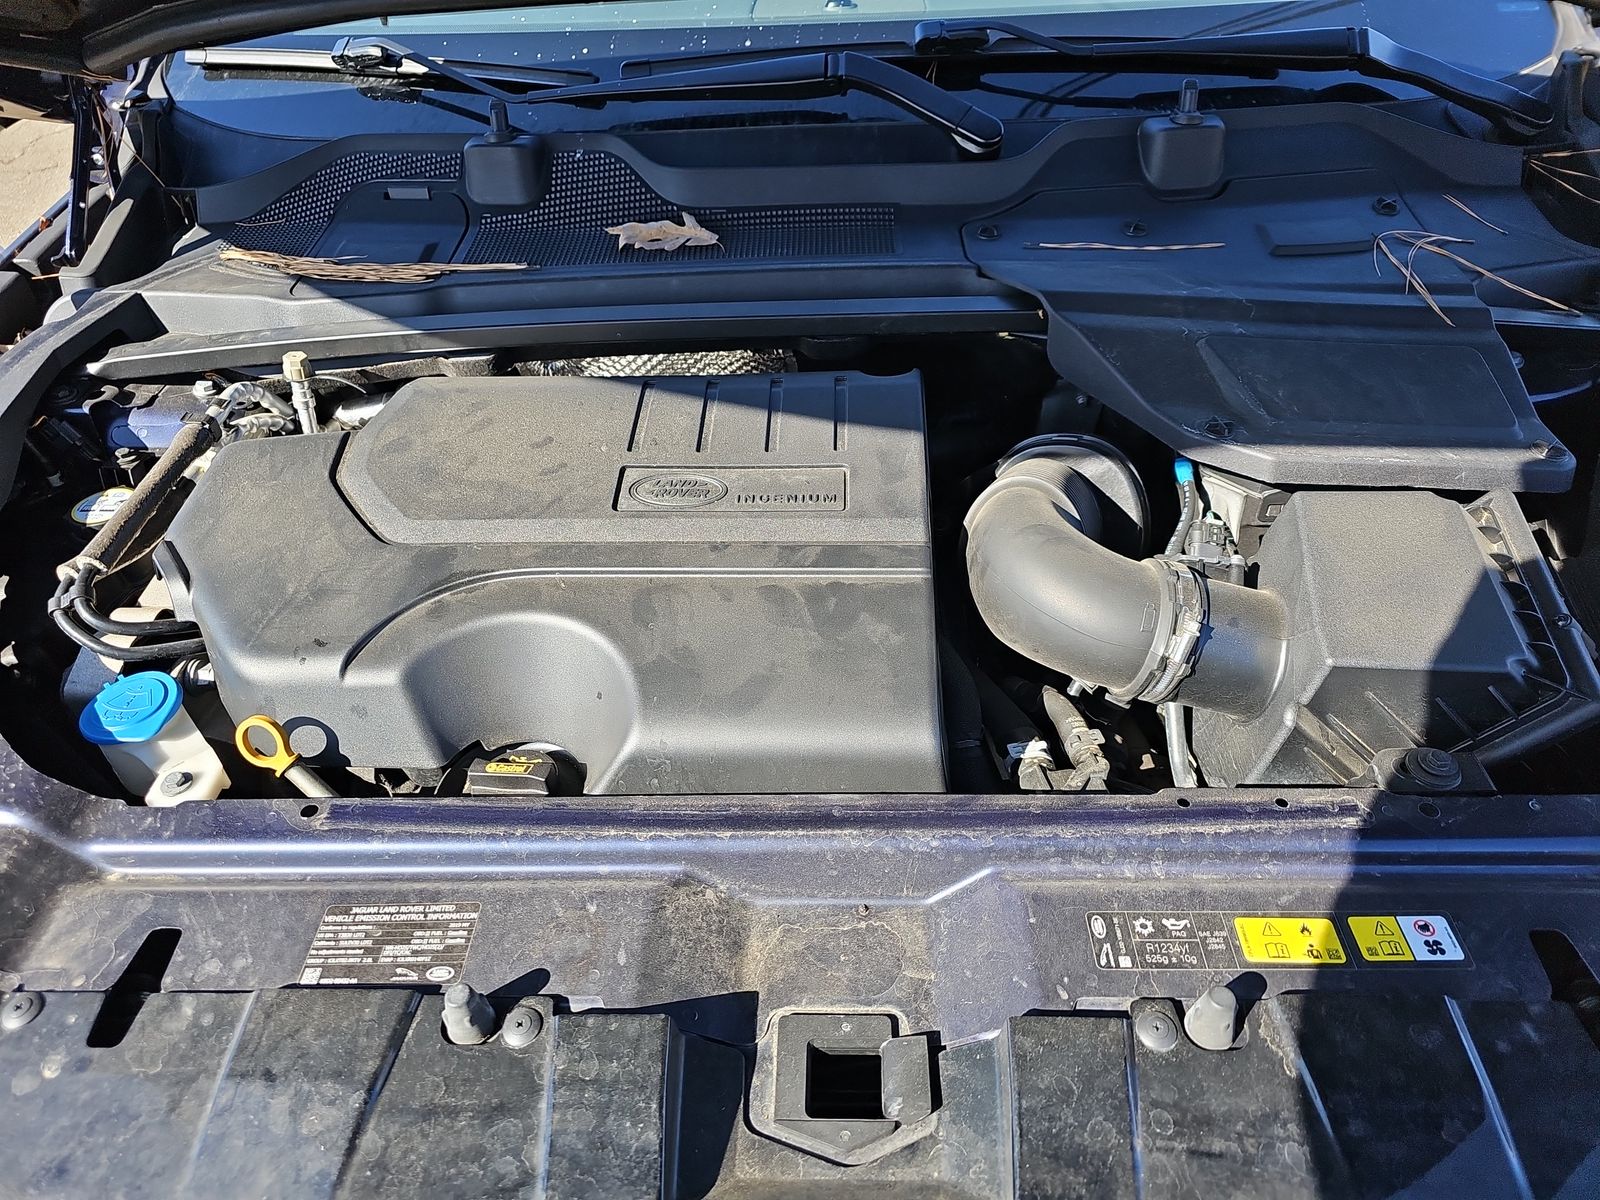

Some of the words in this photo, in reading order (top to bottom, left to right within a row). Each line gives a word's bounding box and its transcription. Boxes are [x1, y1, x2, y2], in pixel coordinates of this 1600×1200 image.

[653, 479, 698, 488] LAND
[654, 488, 710, 498] ROVER
[736, 493, 838, 504] INGENIUM
[497, 764, 527, 773] Castrol
[350, 906, 378, 914] JAGUAR
[379, 906, 399, 914] LAND
[399, 905, 425, 913] ROVER
[425, 904, 456, 912] LIMITED
[324, 914, 354, 923] VEHICLE
[355, 914, 391, 922] EMISSION
[391, 913, 425, 921] CONTROL
[425, 912, 478, 920] INFORMATION
[1171, 930, 1187, 938] PAG
[1145, 942, 1190, 955] R1234yf
[1145, 954, 1169, 965] 525g
[1180, 954, 1198, 965] 10g
